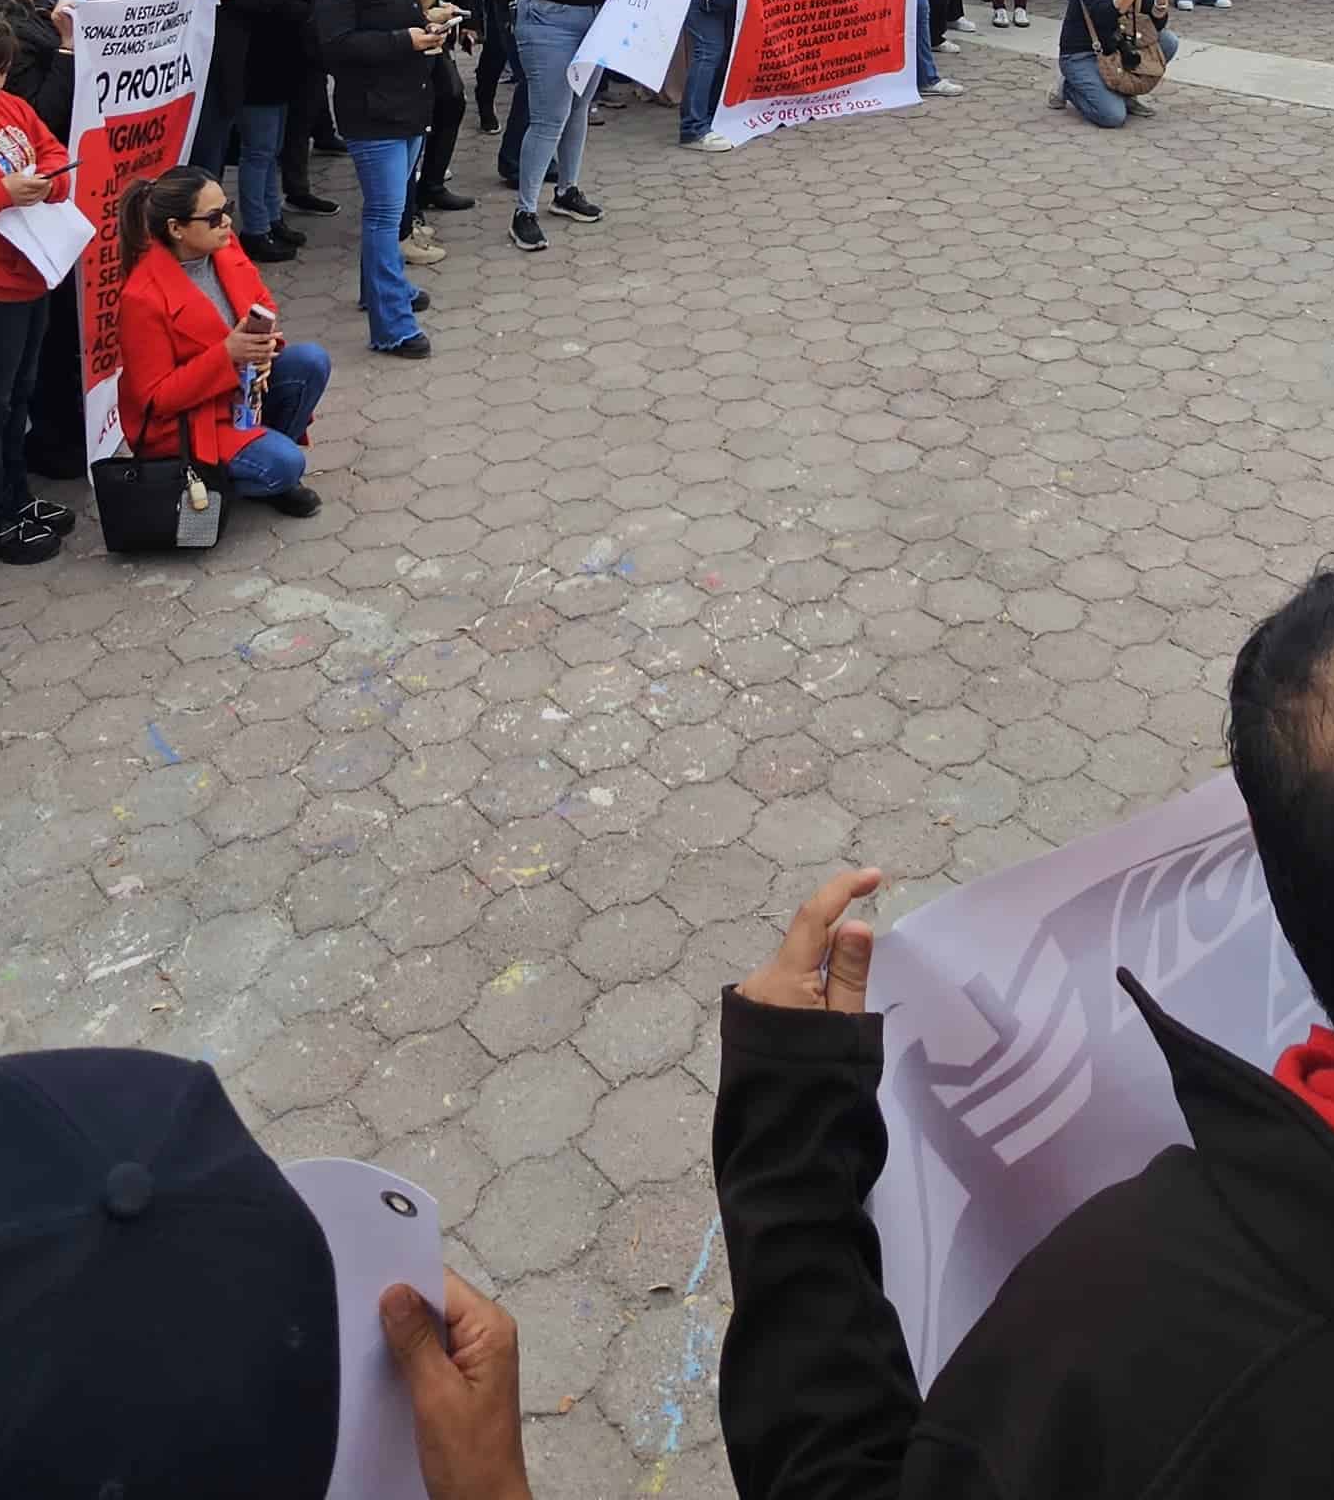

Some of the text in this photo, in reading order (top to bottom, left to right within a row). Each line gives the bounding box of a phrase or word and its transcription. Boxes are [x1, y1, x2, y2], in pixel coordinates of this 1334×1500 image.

[793, 1, 809, 12] DE
[125, 7, 136, 21] EN
[796, 25, 809, 36] DE
[837, 31, 849, 42] DE
[851, 27, 868, 39] LOS
[102, 40, 146, 56] ESTAMOS
[778, 108, 798, 121] DEL
